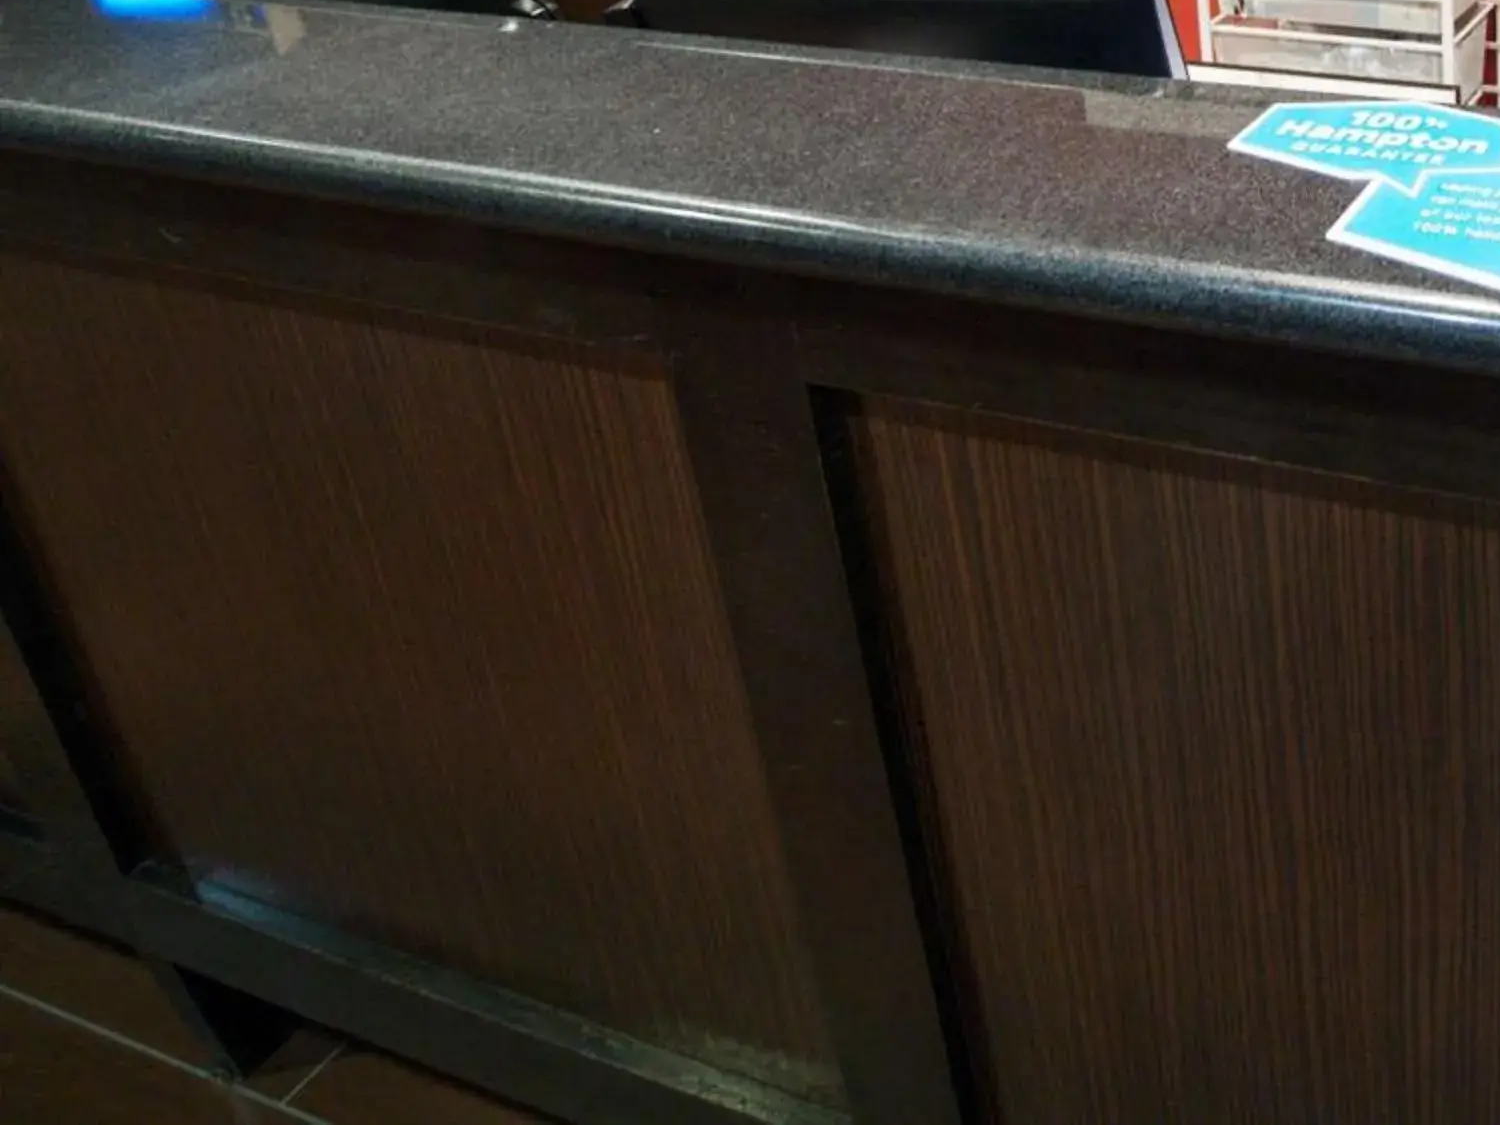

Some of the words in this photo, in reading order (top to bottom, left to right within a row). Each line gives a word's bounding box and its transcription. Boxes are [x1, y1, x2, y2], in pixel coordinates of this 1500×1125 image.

[1351, 111, 1449, 132] 100%
[1275, 118, 1489, 156] Hampton
[1290, 140, 1446, 166] GUARANTEE
